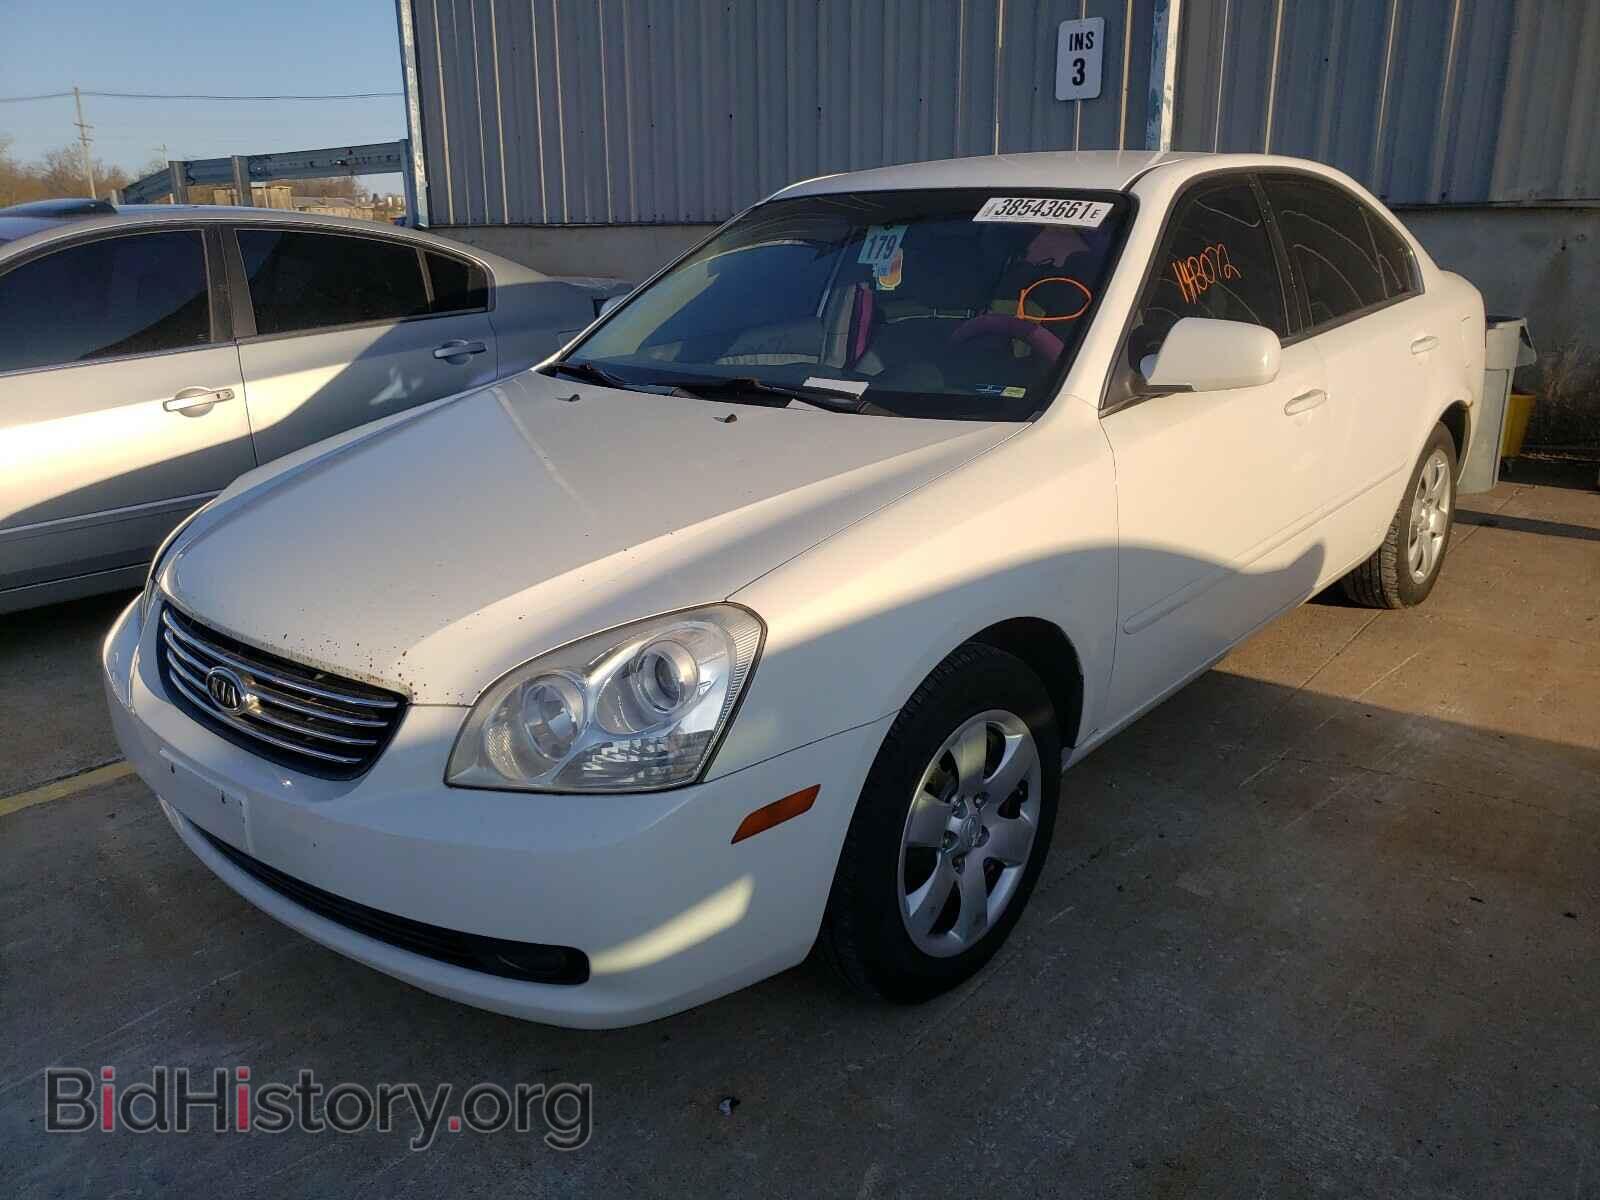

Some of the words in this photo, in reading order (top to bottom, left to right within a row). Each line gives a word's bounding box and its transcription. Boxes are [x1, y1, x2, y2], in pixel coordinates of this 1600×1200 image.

[1069, 31, 1095, 52] INS
[1072, 57, 1086, 86] 3
[994, 199, 1093, 220] 38543661
[866, 234, 897, 259] 179
[211, 676, 238, 708] KIA
